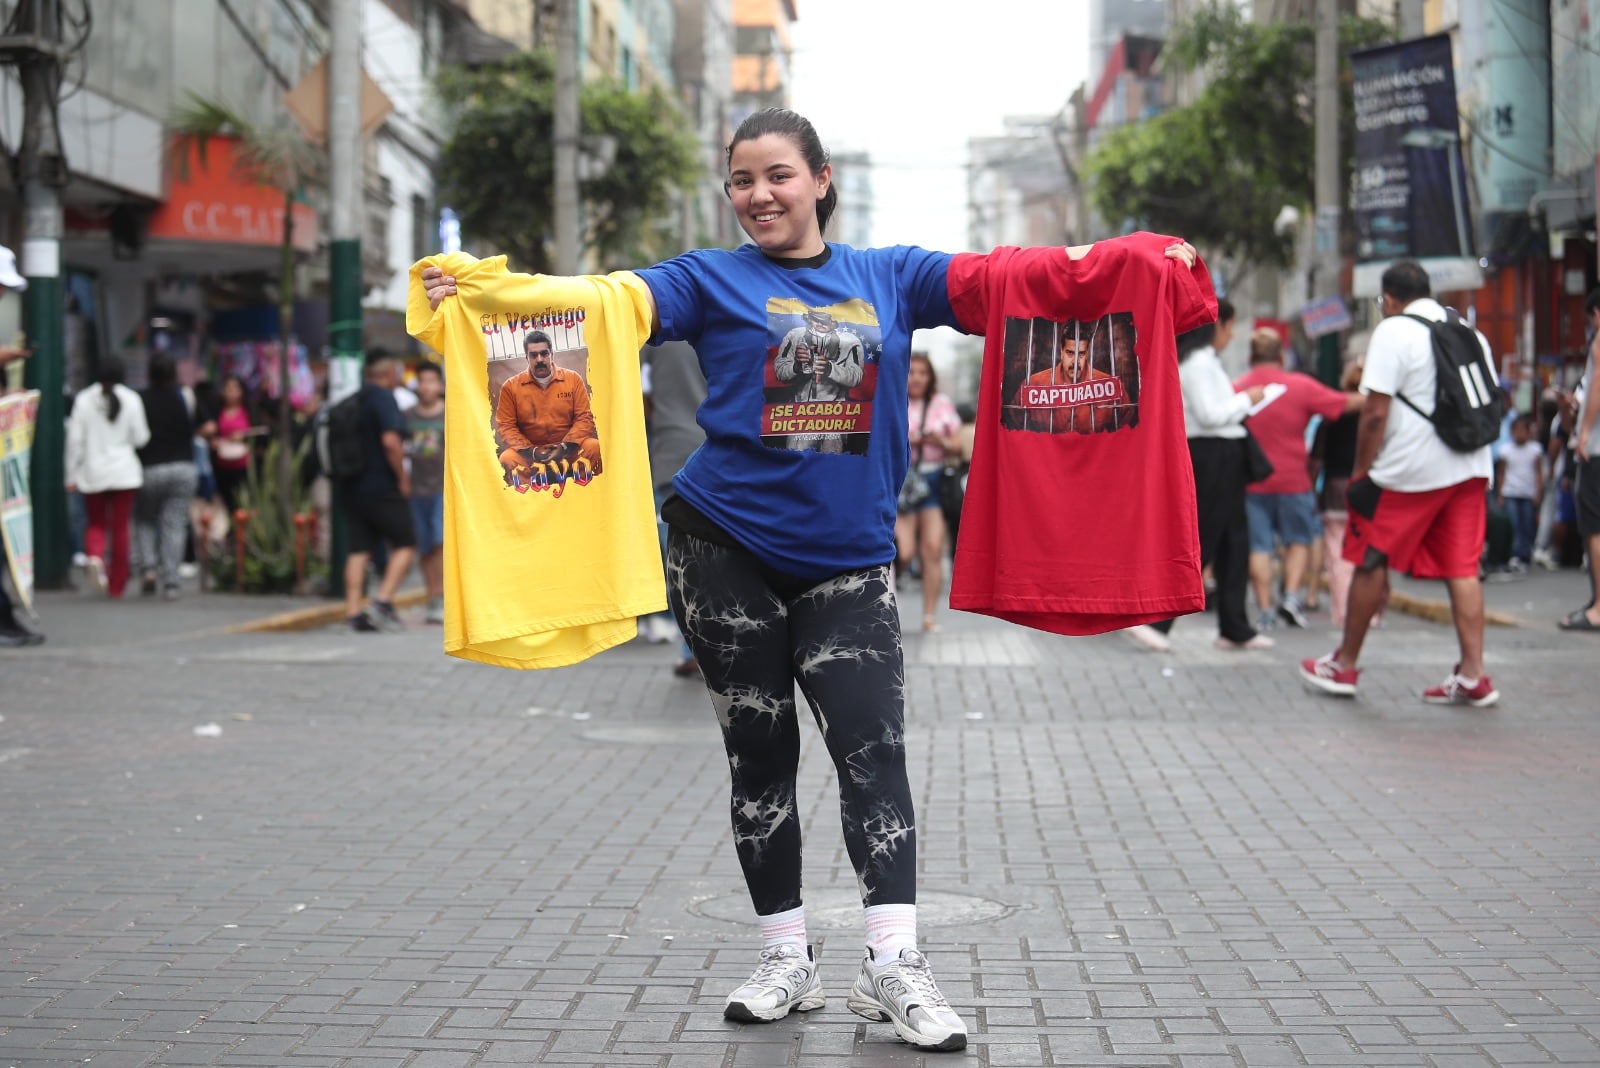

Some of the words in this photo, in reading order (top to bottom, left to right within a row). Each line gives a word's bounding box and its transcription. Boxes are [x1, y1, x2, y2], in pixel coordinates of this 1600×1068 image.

[480, 313, 500, 335] El
[505, 305, 586, 334] Verdugo
[1028, 381, 1115, 405] CAPTURADO
[770, 405, 794, 419] ¡SE
[796, 401, 843, 416] ACABÓ
[846, 403, 861, 415] LA
[771, 418, 856, 432] DICTADURA!
